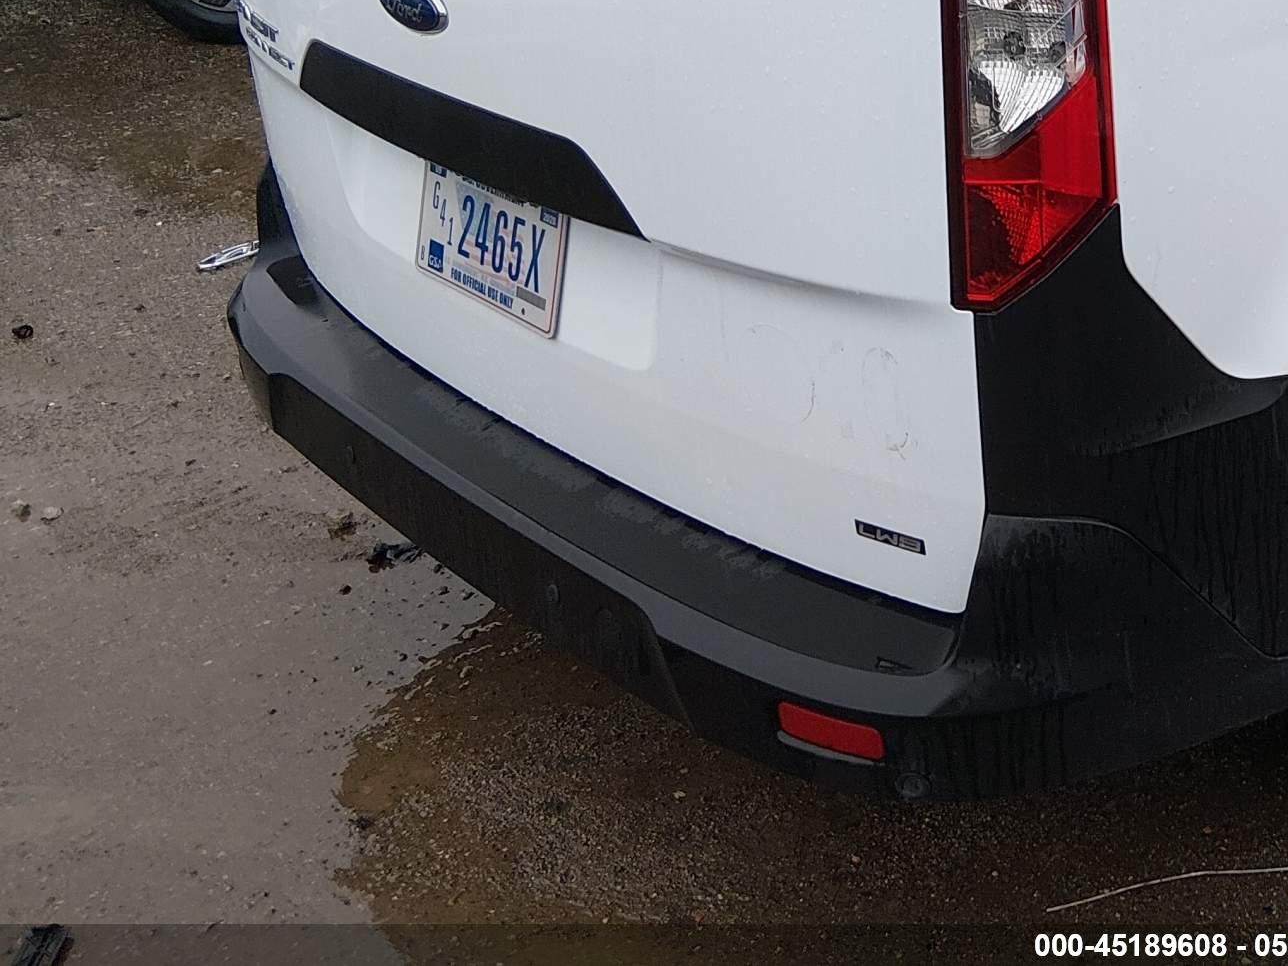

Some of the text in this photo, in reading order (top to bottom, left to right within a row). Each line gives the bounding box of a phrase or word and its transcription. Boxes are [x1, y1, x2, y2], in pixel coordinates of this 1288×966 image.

[428, 254, 442, 269] GSA
[457, 195, 546, 294] 2465X
[450, 267, 514, 309] FOR OFFICIAL USE ONLY
